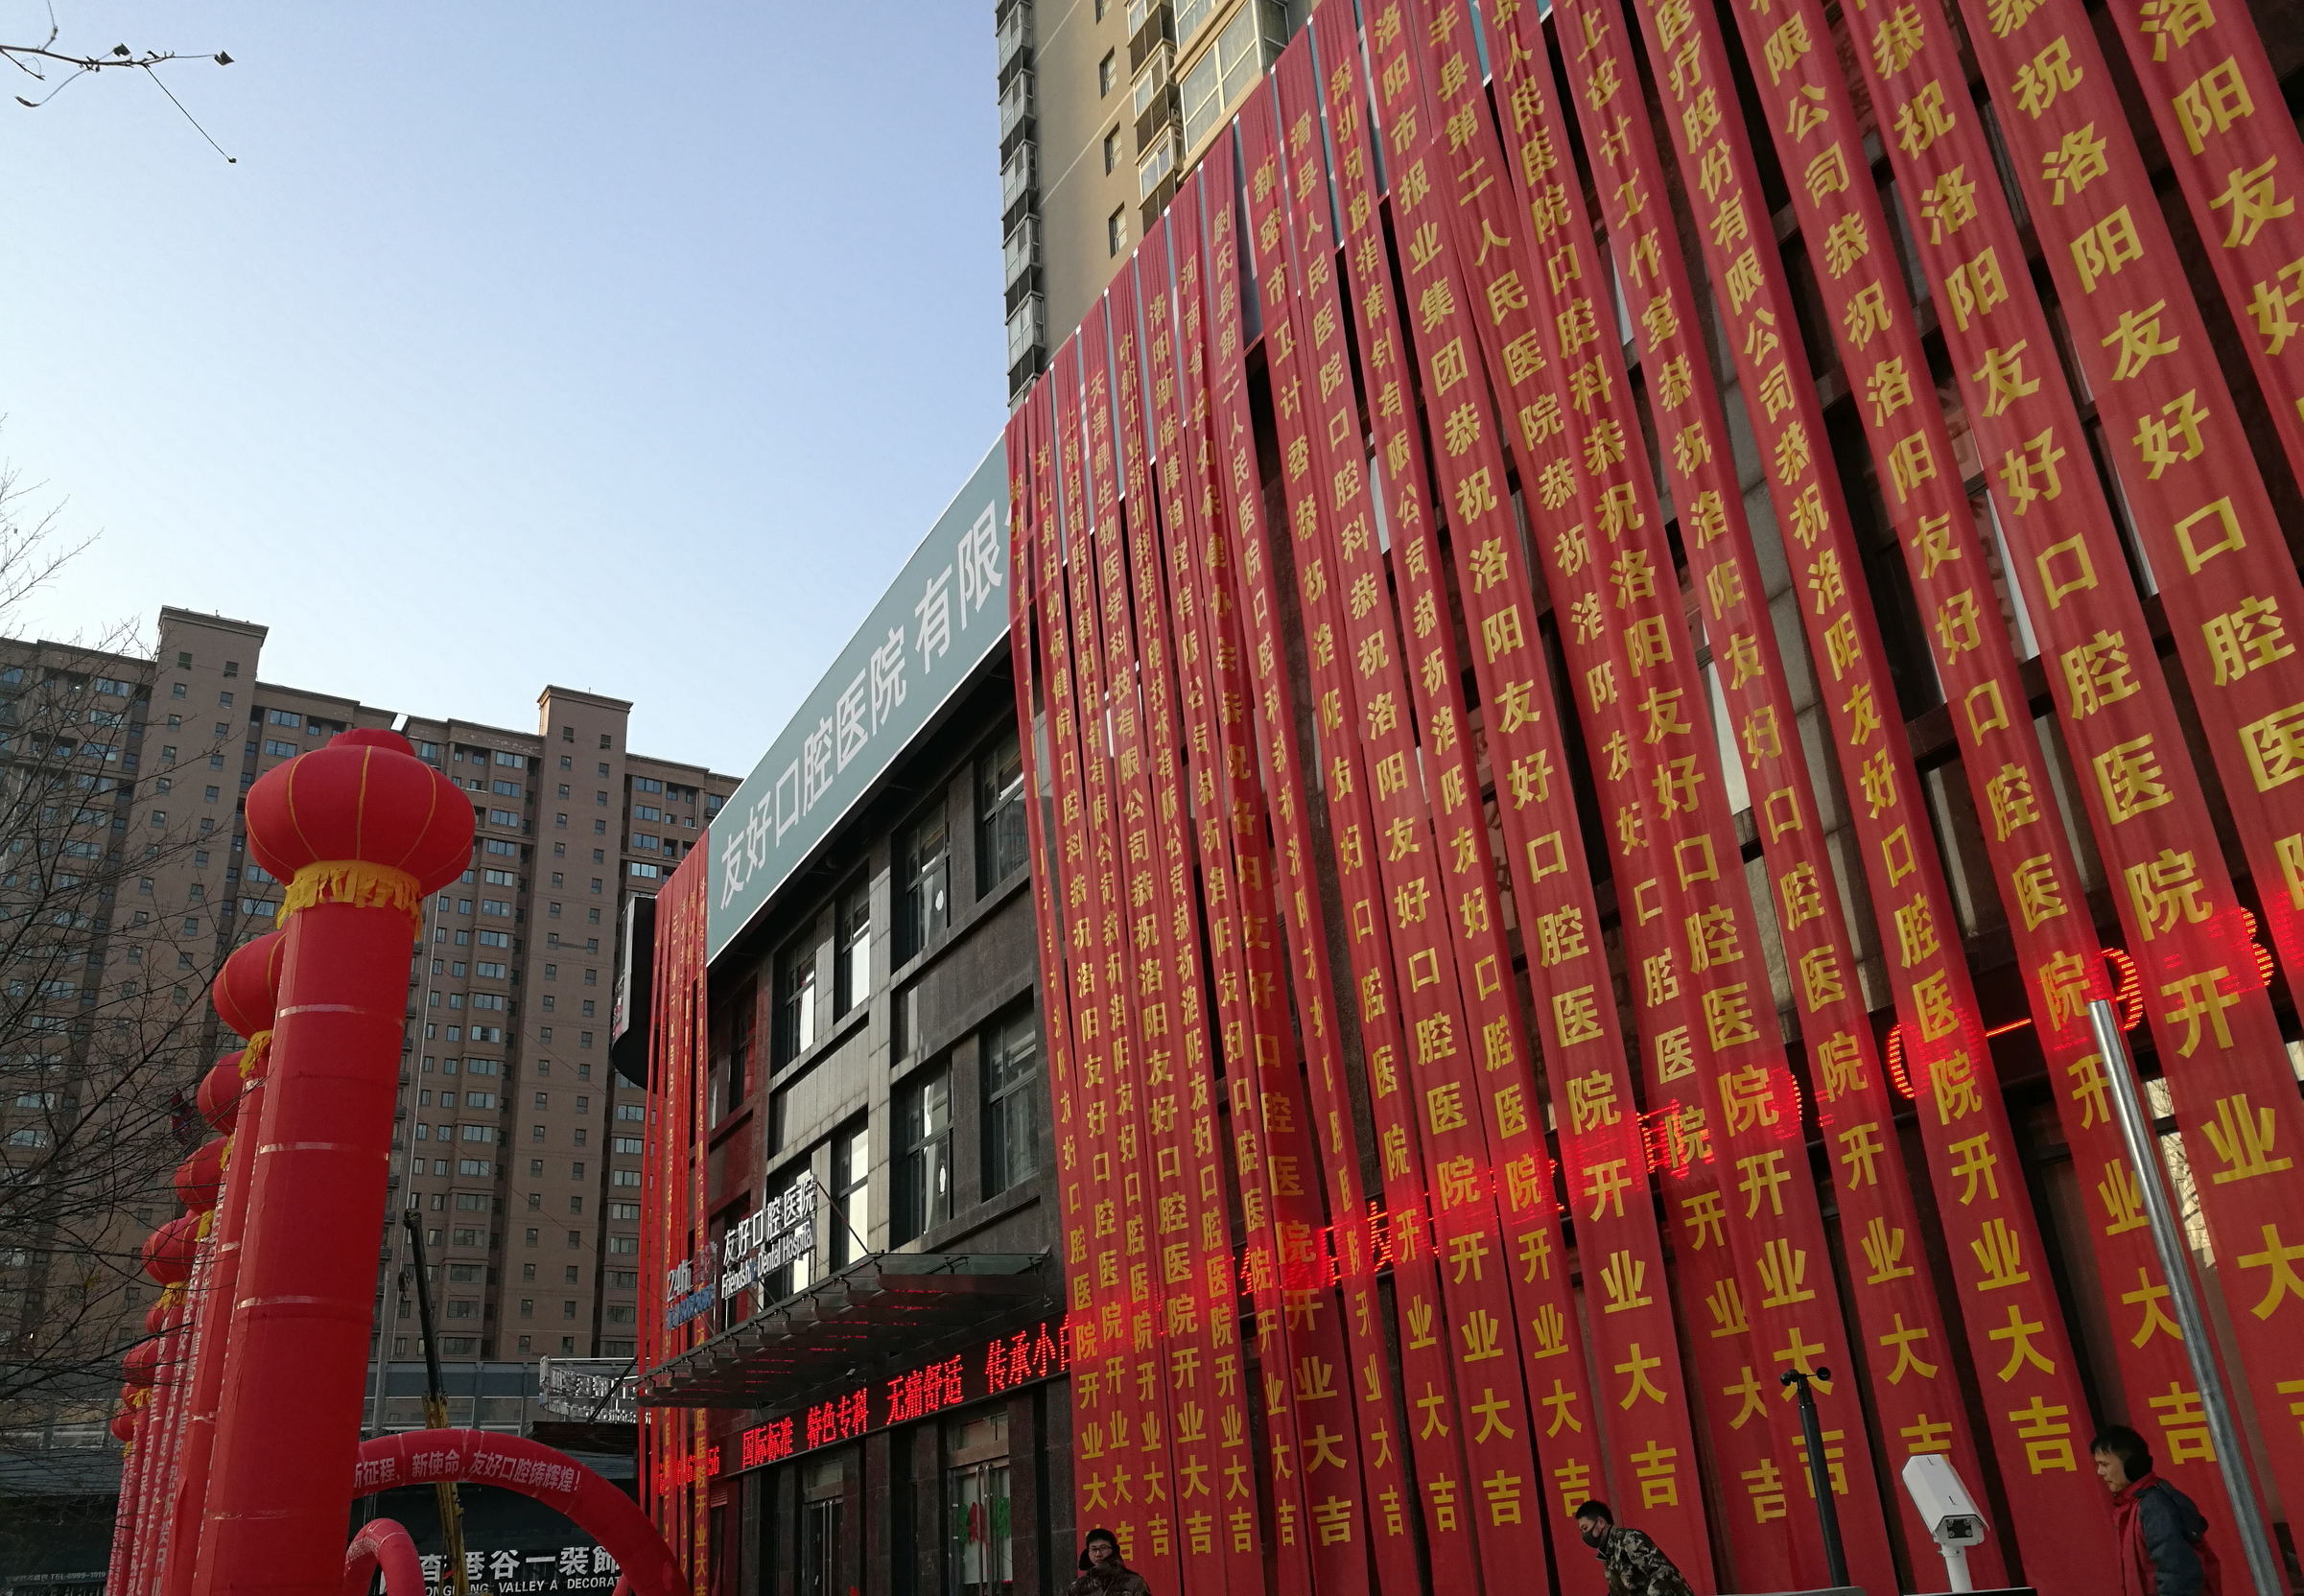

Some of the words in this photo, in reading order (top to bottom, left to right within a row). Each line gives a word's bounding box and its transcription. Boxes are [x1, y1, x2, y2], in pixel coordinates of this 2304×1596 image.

[2138, 0, 2304, 423] 洛阳友好
[719, 499, 1010, 910] 友好口腔医院有限
[1374, 2, 1680, 1511] 洛阳市报业集团恭祝洛阳友好口腔医院开业大吉
[1423, 0, 1788, 1524] 丰县第二人民医院恭祝洛阳友好口腔医院开业大吉
[1564, 0, 1953, 1462] 上设计工作室恭祝洛阳友好口腔医院开业大吉
[1647, 0, 2078, 1475] 医疗股份有限公司恭祝洛阳友好口腔医院开业大吉
[1749, 0, 2218, 1465] 限公司恭祝洛阳友好口腔医院开业大吉
[1856, 0, 2304, 1434] 恭祝洛阳友好口腔医院开业大
[499, 1579, 544, 1593] VALLEY
[550, 1579, 558, 1591] A
[723, 1173, 817, 1267] 友好口腔医院
[741, 1417, 794, 1470] 国际标准
[807, 1387, 868, 1451] 特色专科
[885, 1353, 964, 1426] 无痛舒适
[758, 1237, 782, 1279] Dental
[783, 1224, 813, 1263] Hospital
